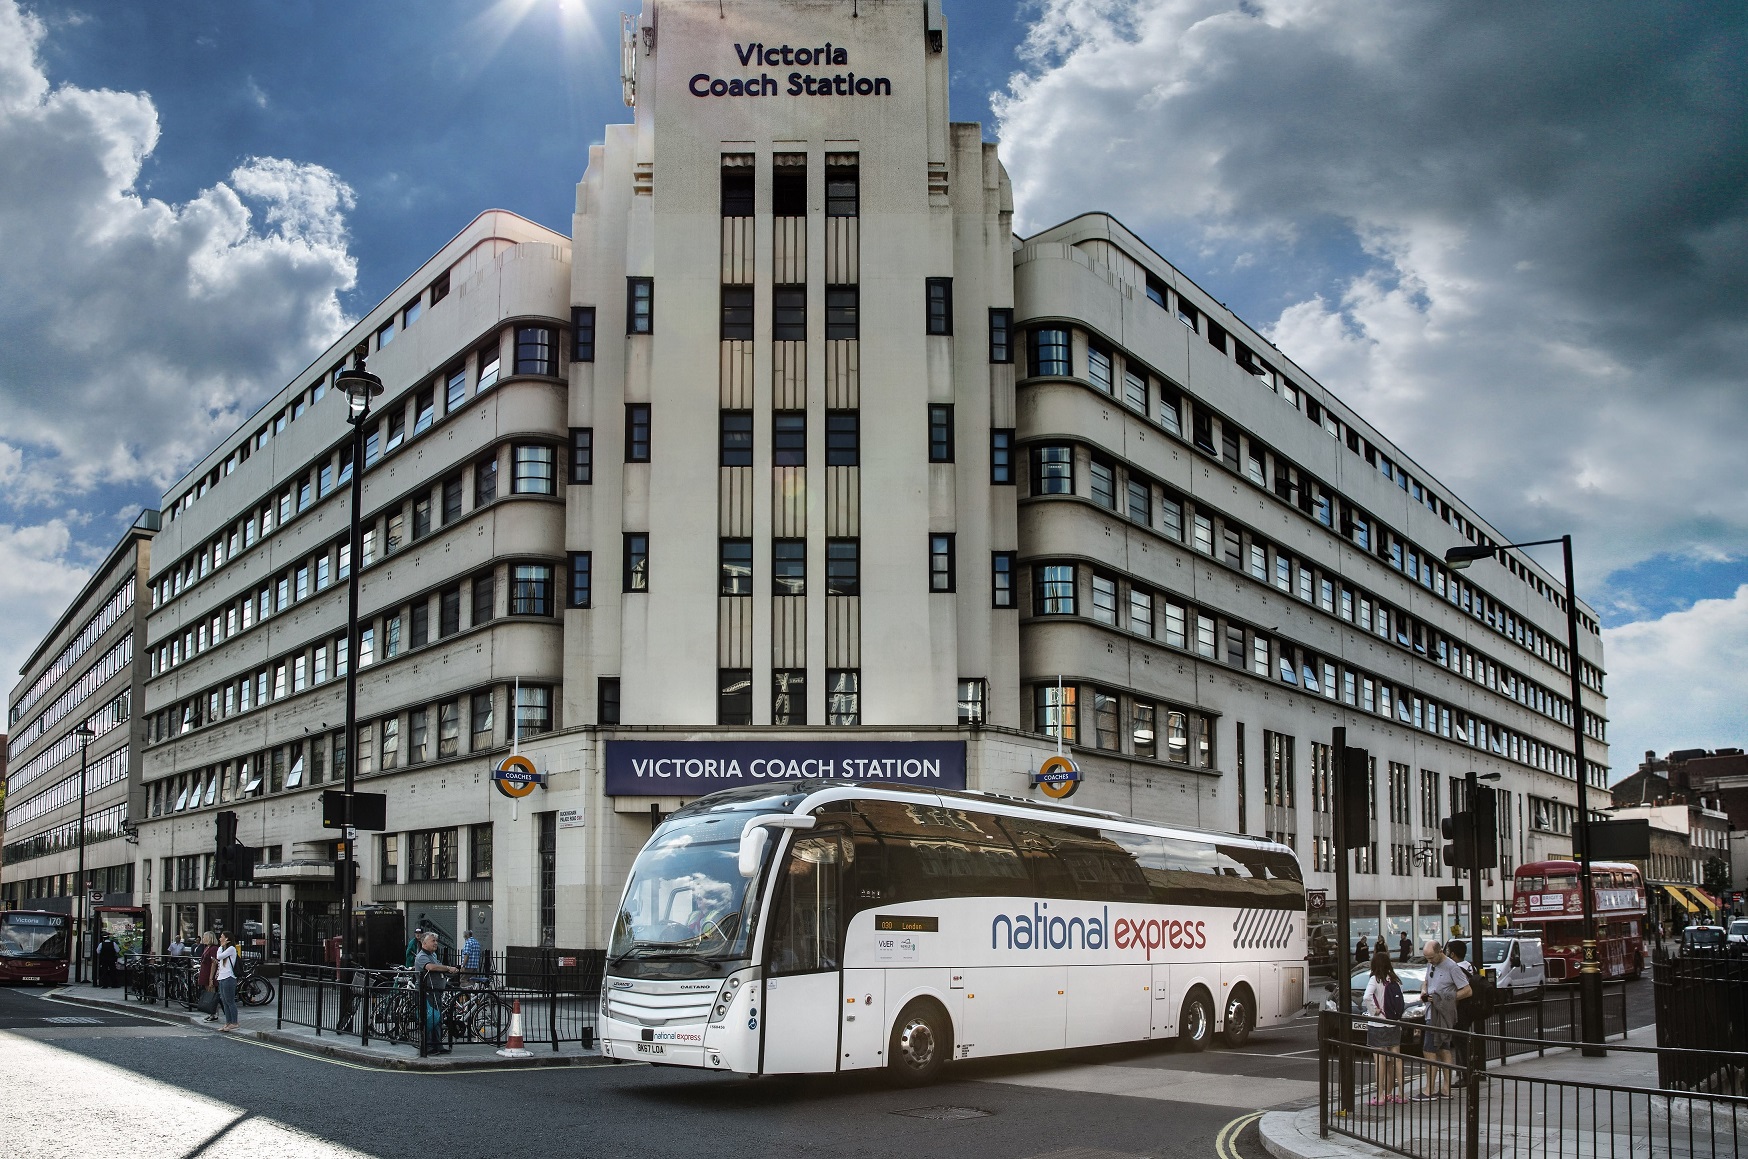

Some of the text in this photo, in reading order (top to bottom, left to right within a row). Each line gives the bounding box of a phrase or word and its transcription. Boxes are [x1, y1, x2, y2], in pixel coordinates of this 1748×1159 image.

[734, 42, 848, 67] Victoria
[688, 72, 891, 97] Coach Station
[631, 758, 941, 778] VICTORIA COACH STATION
[505, 772, 532, 781] COACHES
[1043, 773, 1069, 781] COACHES
[15, 916, 62, 926] Victoria 170
[881, 921, 923, 930] 030 London
[991, 902, 1206, 961] national express
[653, 1031, 702, 1042] national express
[637, 1043, 651, 1053] BK67
